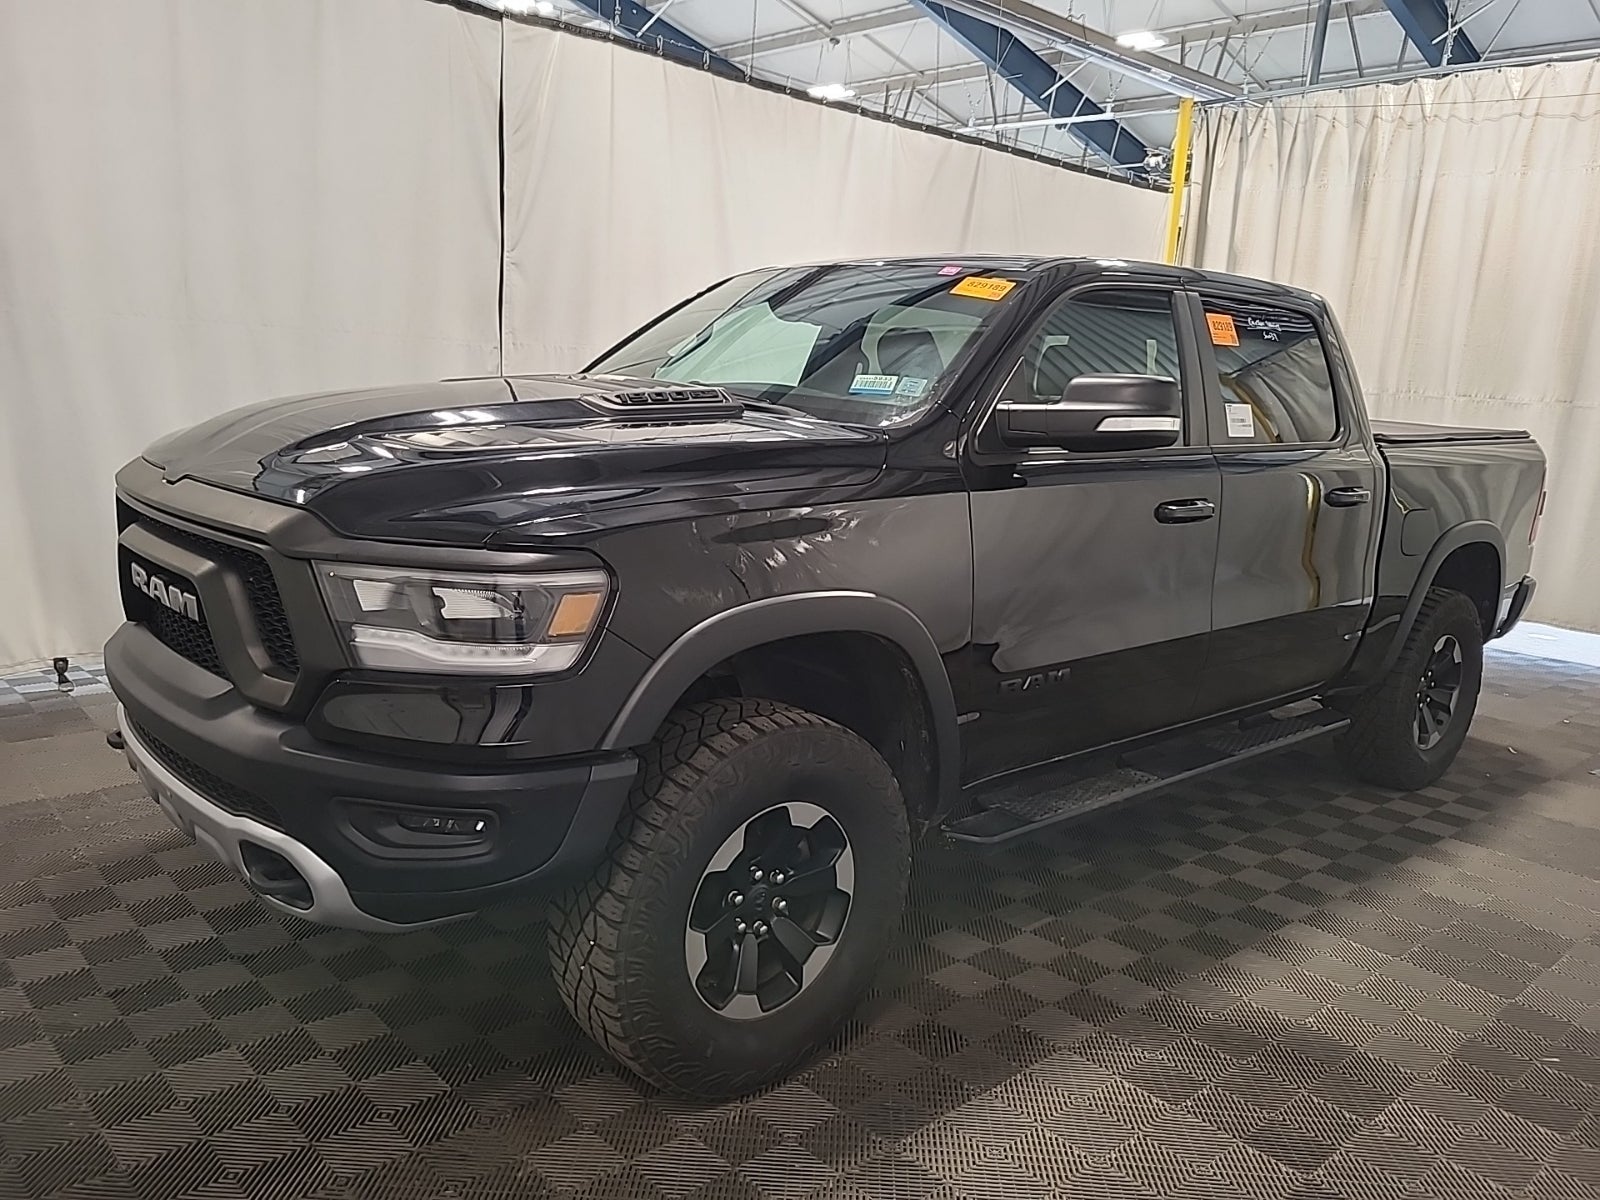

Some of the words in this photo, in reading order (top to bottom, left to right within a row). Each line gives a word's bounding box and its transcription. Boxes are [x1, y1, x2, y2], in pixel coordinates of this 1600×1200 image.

[967, 281, 1007, 292] 829189
[131, 562, 199, 622] RAM
[998, 667, 1071, 694] RAM
